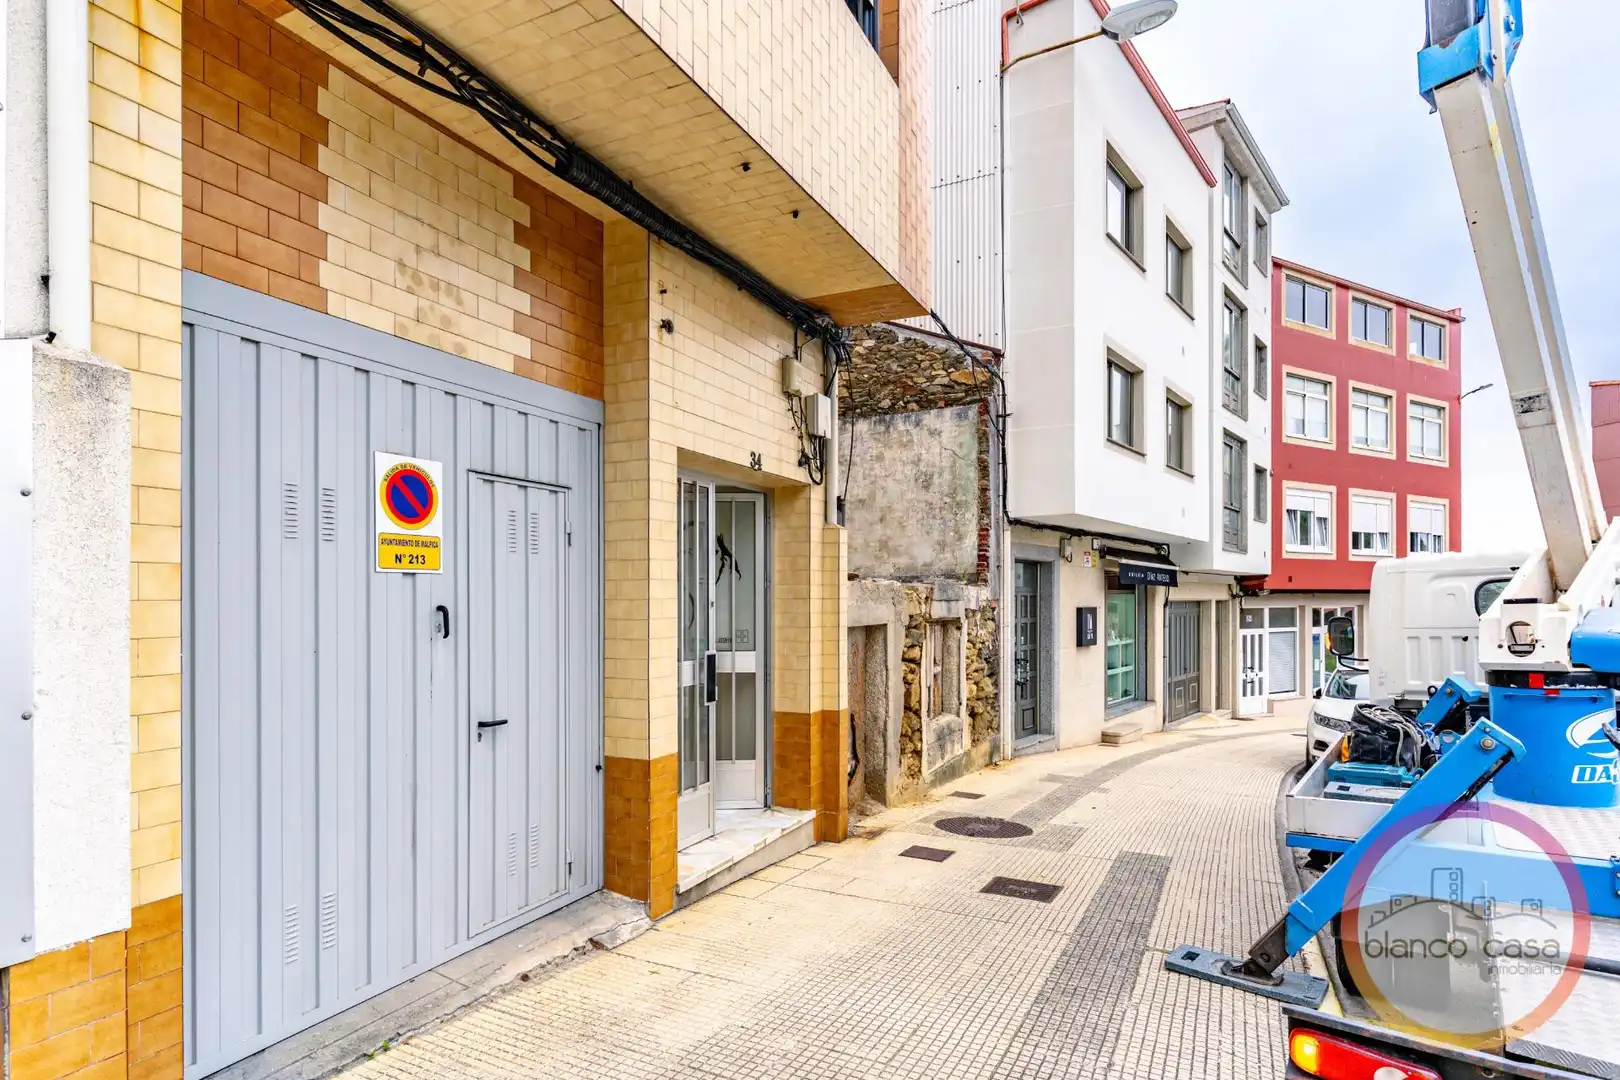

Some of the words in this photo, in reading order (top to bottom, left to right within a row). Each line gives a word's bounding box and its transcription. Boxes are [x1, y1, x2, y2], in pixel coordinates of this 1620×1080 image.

[750, 451, 762, 470] 34
[384, 464, 399, 482] SALIDA
[381, 538, 414, 547] AYUNTAMIENTO
[421, 540, 439, 548] MALPICA
[408, 554, 426, 565] 213
